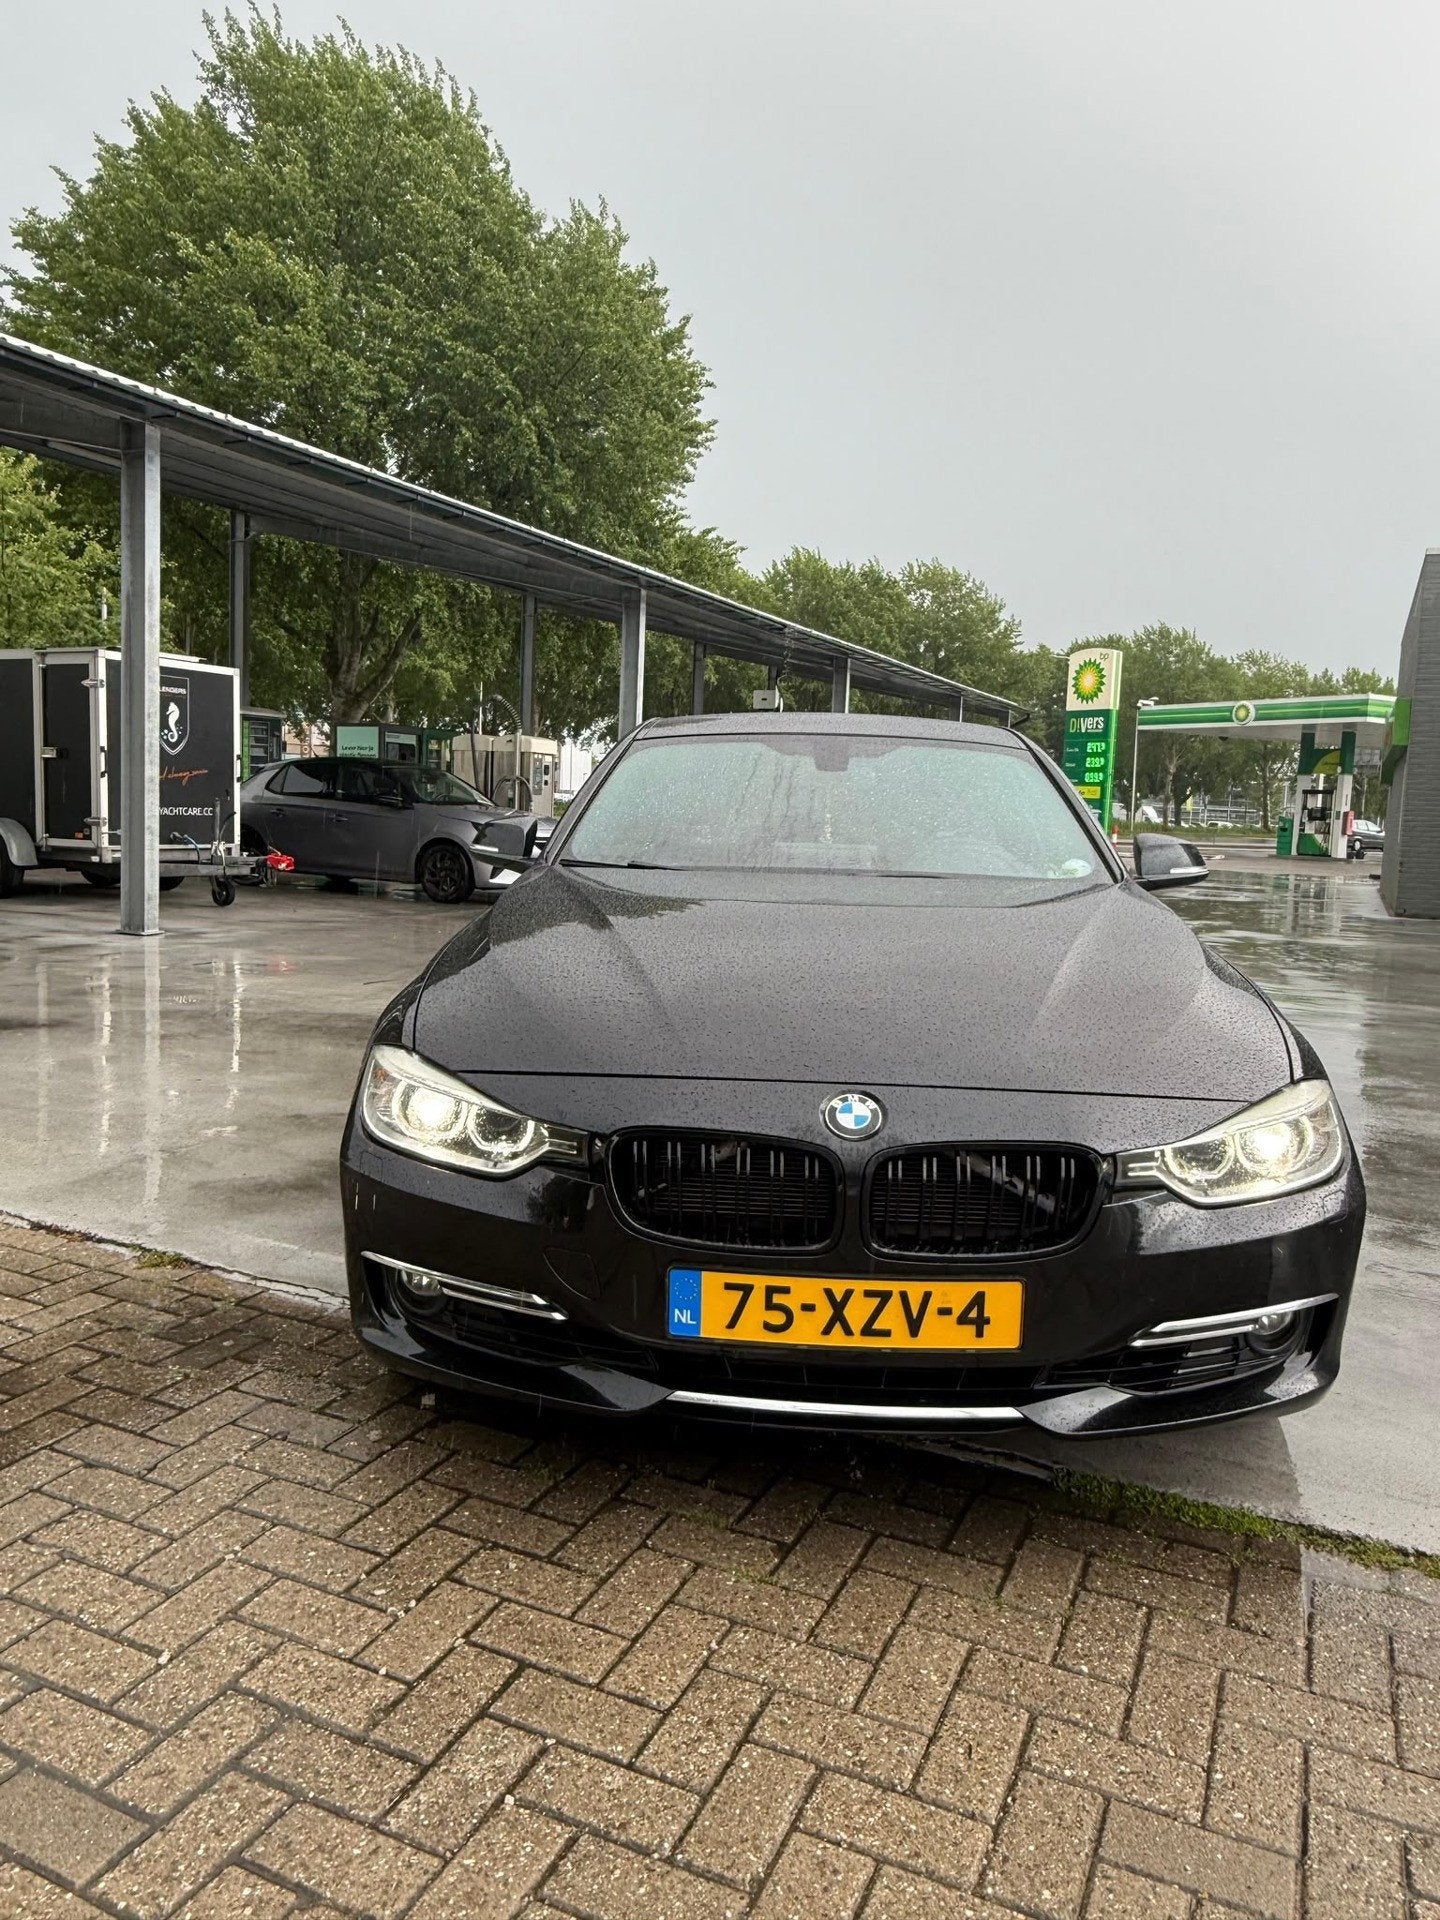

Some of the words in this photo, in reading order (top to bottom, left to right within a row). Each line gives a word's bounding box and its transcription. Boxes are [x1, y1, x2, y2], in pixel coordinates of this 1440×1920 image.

[1099, 652, 1110, 662] bp
[830, 1094, 878, 1110] BMW
[674, 1308, 697, 1325] NL
[722, 1281, 991, 1338] 75-XZV-4
